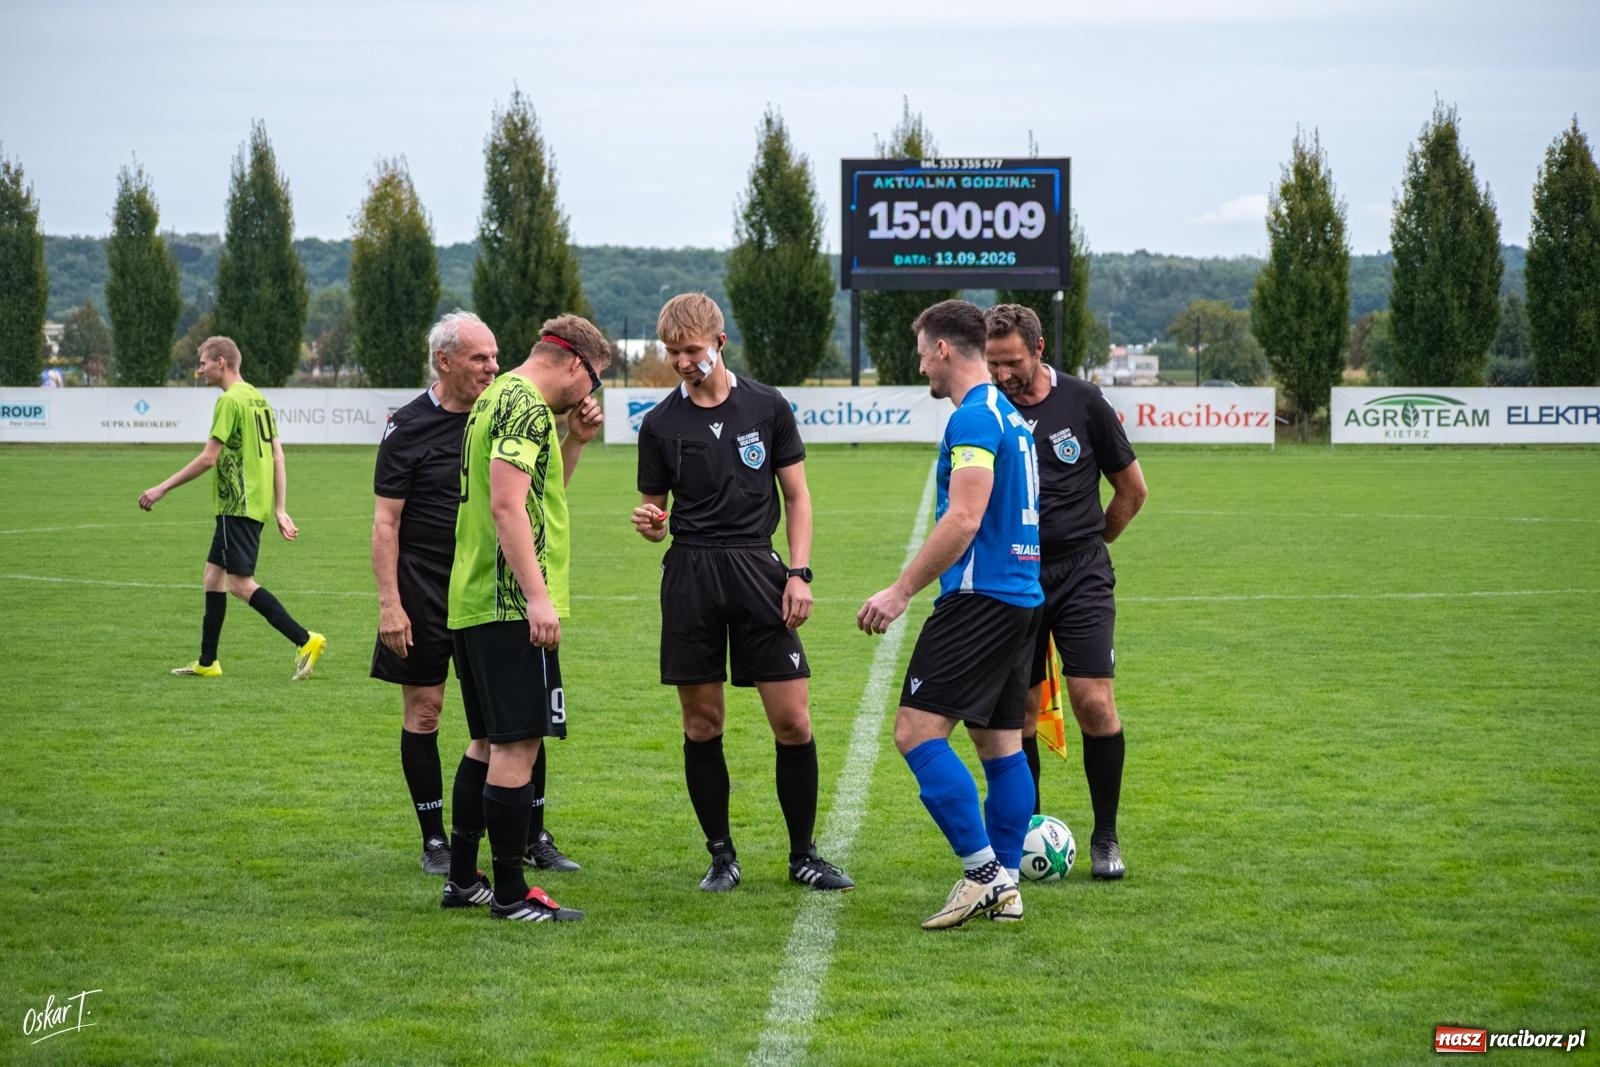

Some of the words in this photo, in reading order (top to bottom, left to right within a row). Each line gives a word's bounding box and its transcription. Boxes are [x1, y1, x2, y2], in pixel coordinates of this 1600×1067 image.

[873, 177, 956, 189] AKTUALNA
[961, 177, 1036, 189] GODZINA:
[868, 201, 1046, 240] 15:00:09
[894, 255, 931, 265] DATA:
[935, 252, 1016, 265] 13.09.2026
[0, 406, 42, 418] ROUP
[332, 408, 376, 424] STAL
[1136, 404, 1269, 427] Racibórz
[1507, 406, 1600, 425] ELEKTR
[101, 420, 131, 429] SUPRA
[1385, 430, 1430, 439] KIETRZ
[498, 437, 522, 457] C
[551, 687, 567, 724] 9
